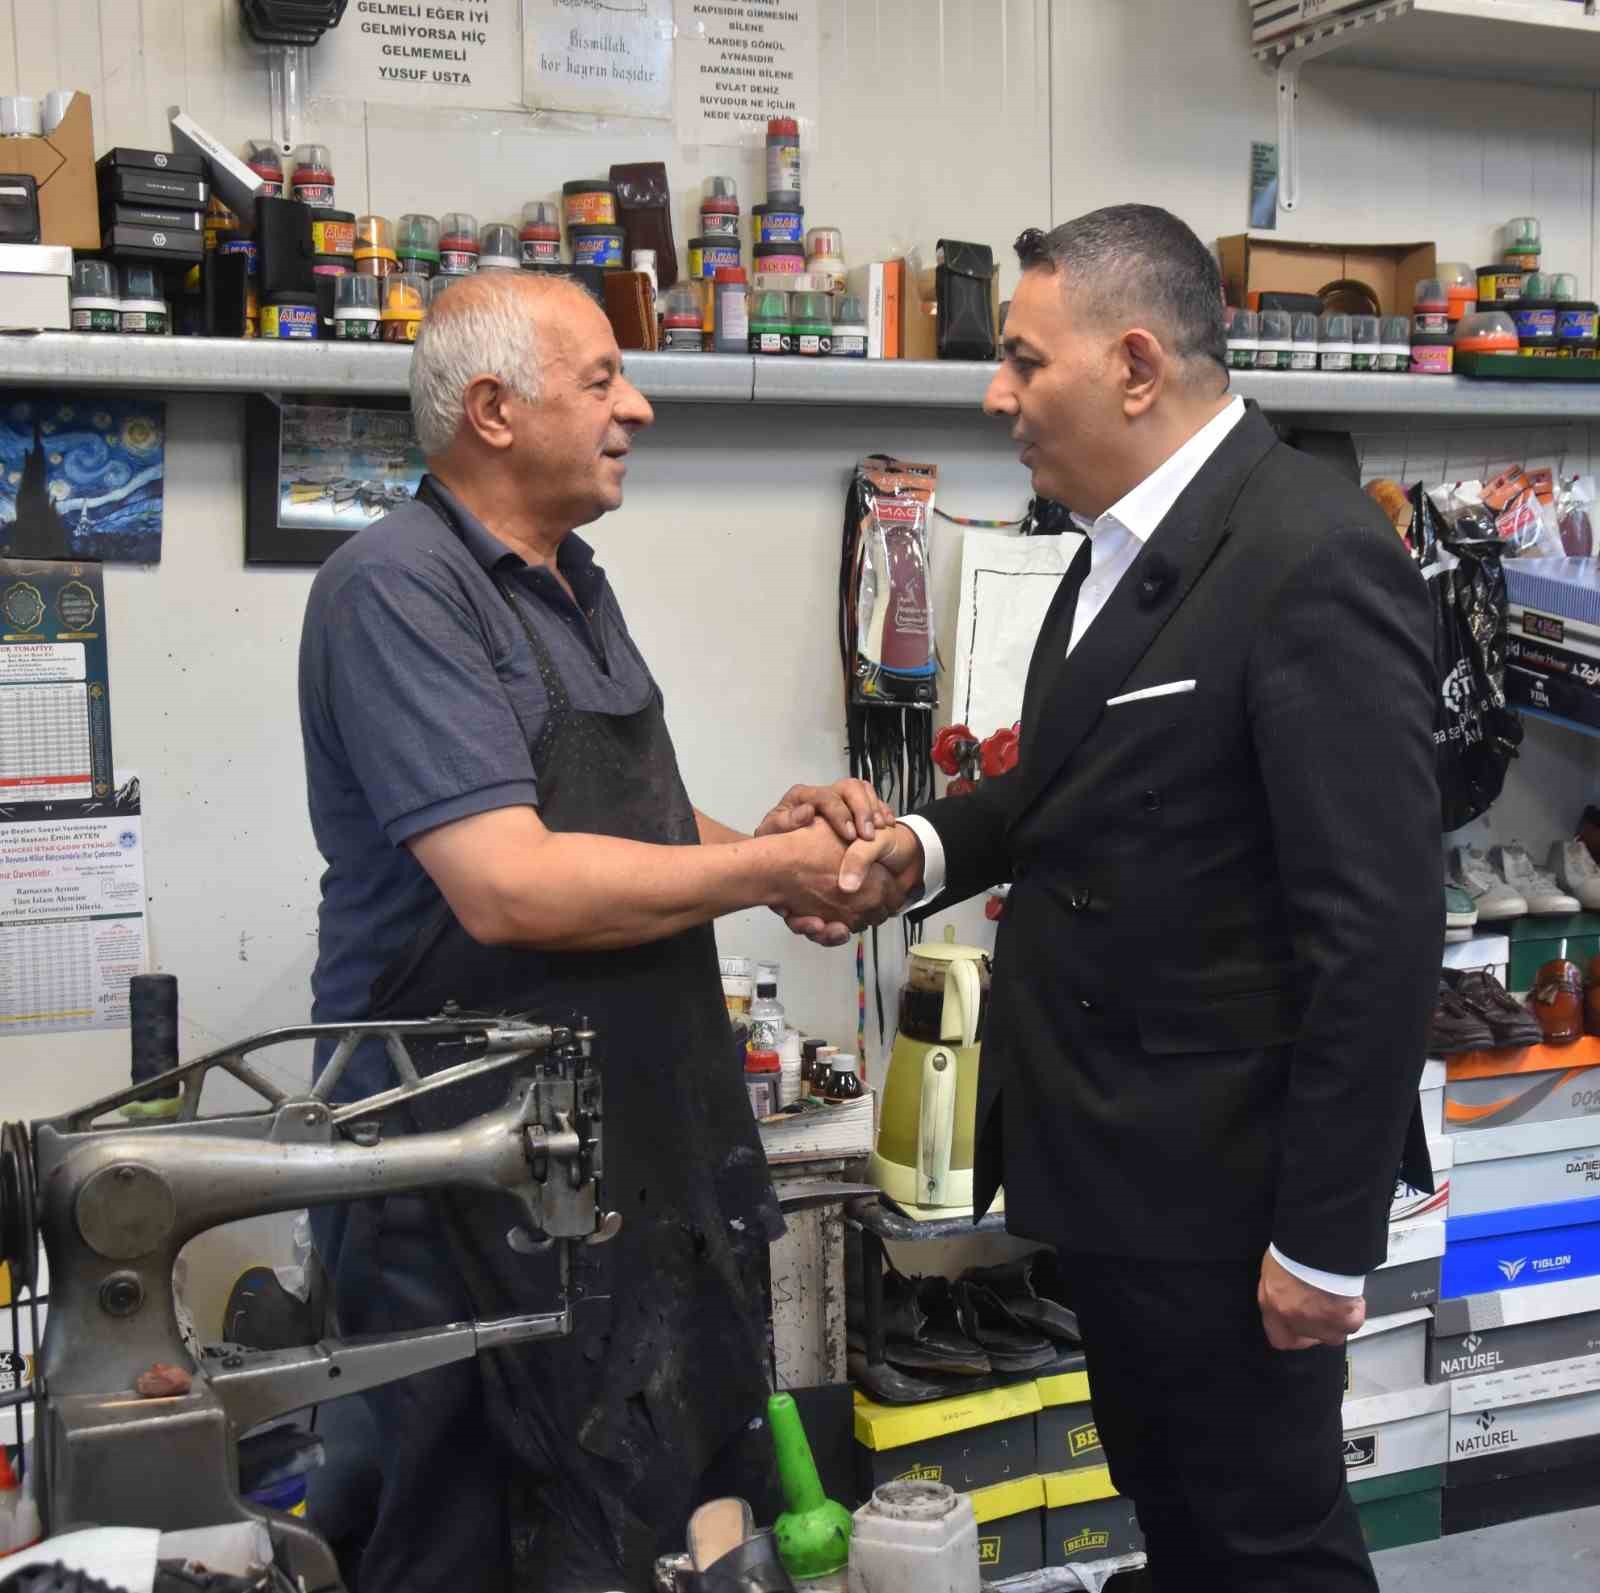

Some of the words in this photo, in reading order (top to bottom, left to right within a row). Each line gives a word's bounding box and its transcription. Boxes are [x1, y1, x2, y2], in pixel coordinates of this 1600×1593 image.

[358, 2, 421, 17] GELMELİ
[426, 6, 464, 21] EĞER
[469, 9, 489, 24] İYİ
[361, 21, 457, 41] GELMİYORSA
[462, 28, 487, 46] HİÇ
[728, 21, 764, 33] BİLENE
[382, 43, 467, 61] GELMEMELİ
[379, 66, 428, 80] YUSUF
[432, 70, 471, 84] USTA
[715, 82, 747, 92] EVLAT
[750, 98, 764, 108] NE
[1566, 1160, 1600, 1173] DANIE
[1532, 1255, 1572, 1270] TIGLON
[1440, 1351, 1505, 1375] NATUREL
[1455, 1429, 1519, 1454] NATUREL
[1067, 1534, 1105, 1551] BEILER
